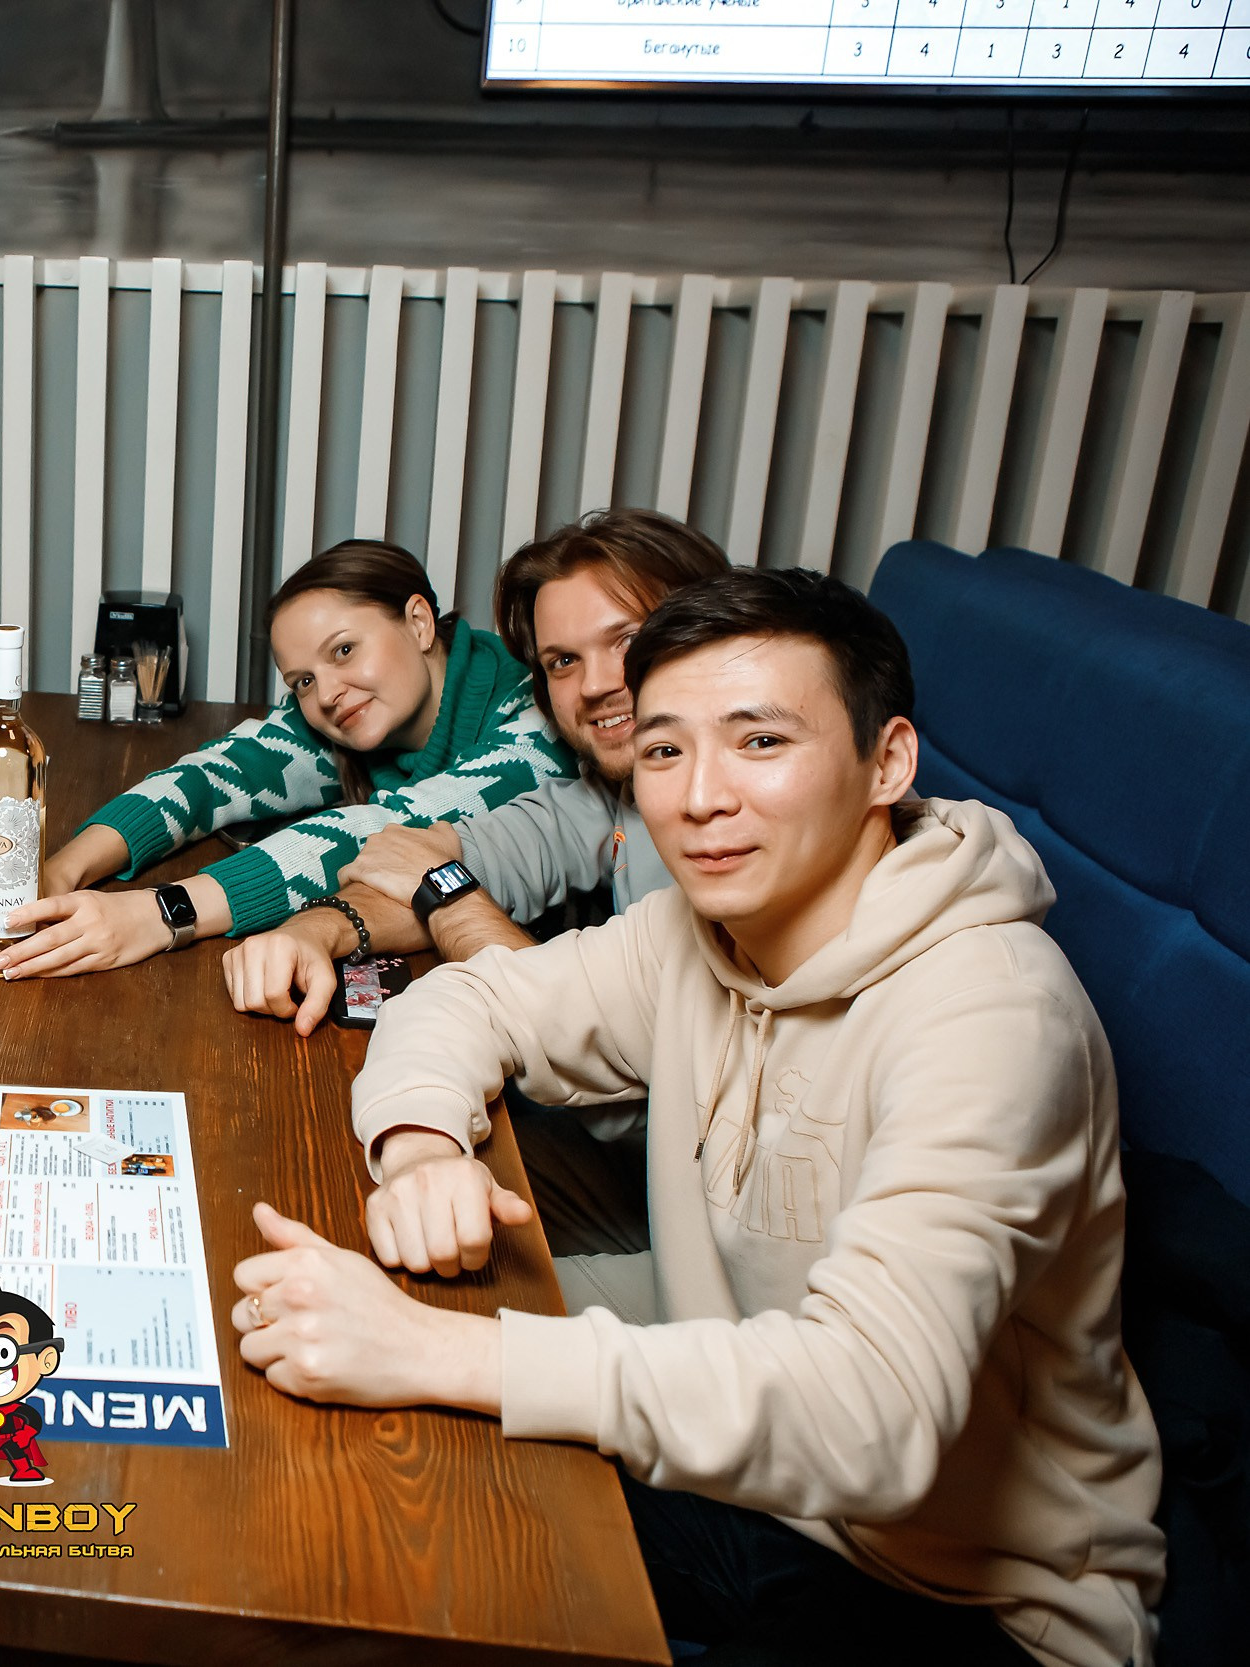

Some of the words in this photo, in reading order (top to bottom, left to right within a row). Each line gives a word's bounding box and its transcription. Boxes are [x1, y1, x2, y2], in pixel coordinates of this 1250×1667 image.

[510, 38, 527, 53] 10
[853, 41, 863, 58] 3
[919, 42, 930, 58] 4
[986, 43, 994, 58] 1
[1052, 43, 1062, 59] 3
[1114, 43, 1125, 59] 2
[1178, 45, 1189, 60] 4
[64, 1302, 78, 1329] ПИВО
